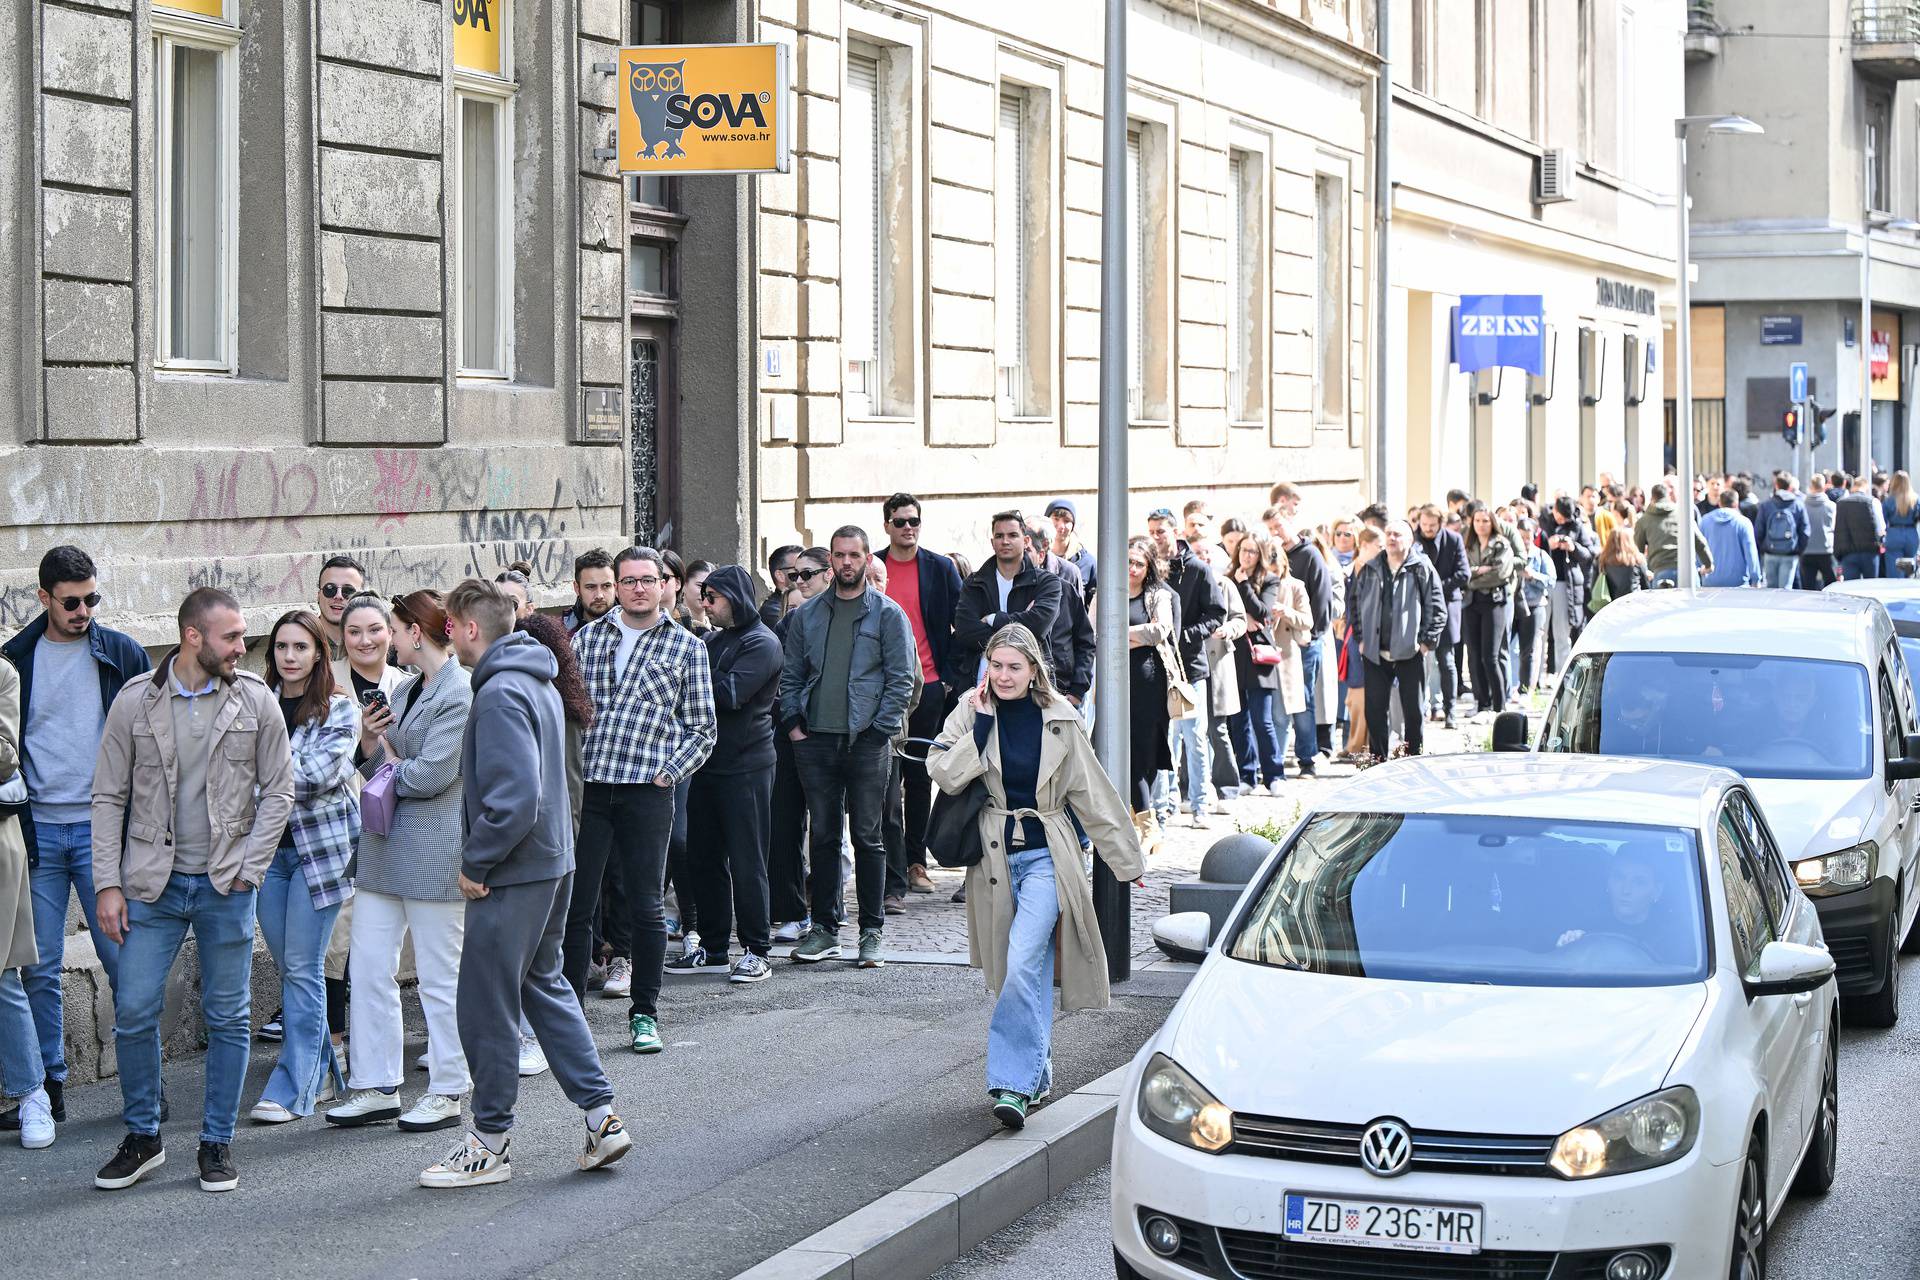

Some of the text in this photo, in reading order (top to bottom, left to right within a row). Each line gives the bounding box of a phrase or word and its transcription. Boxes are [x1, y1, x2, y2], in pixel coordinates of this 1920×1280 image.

[453, 0, 491, 32] OVA
[702, 131, 771, 142] www.sova.hr
[1461, 314, 1540, 337] ZEISS
[1288, 1219, 1303, 1230] HR
[1306, 1201, 1474, 1243] ZD 236-MR
